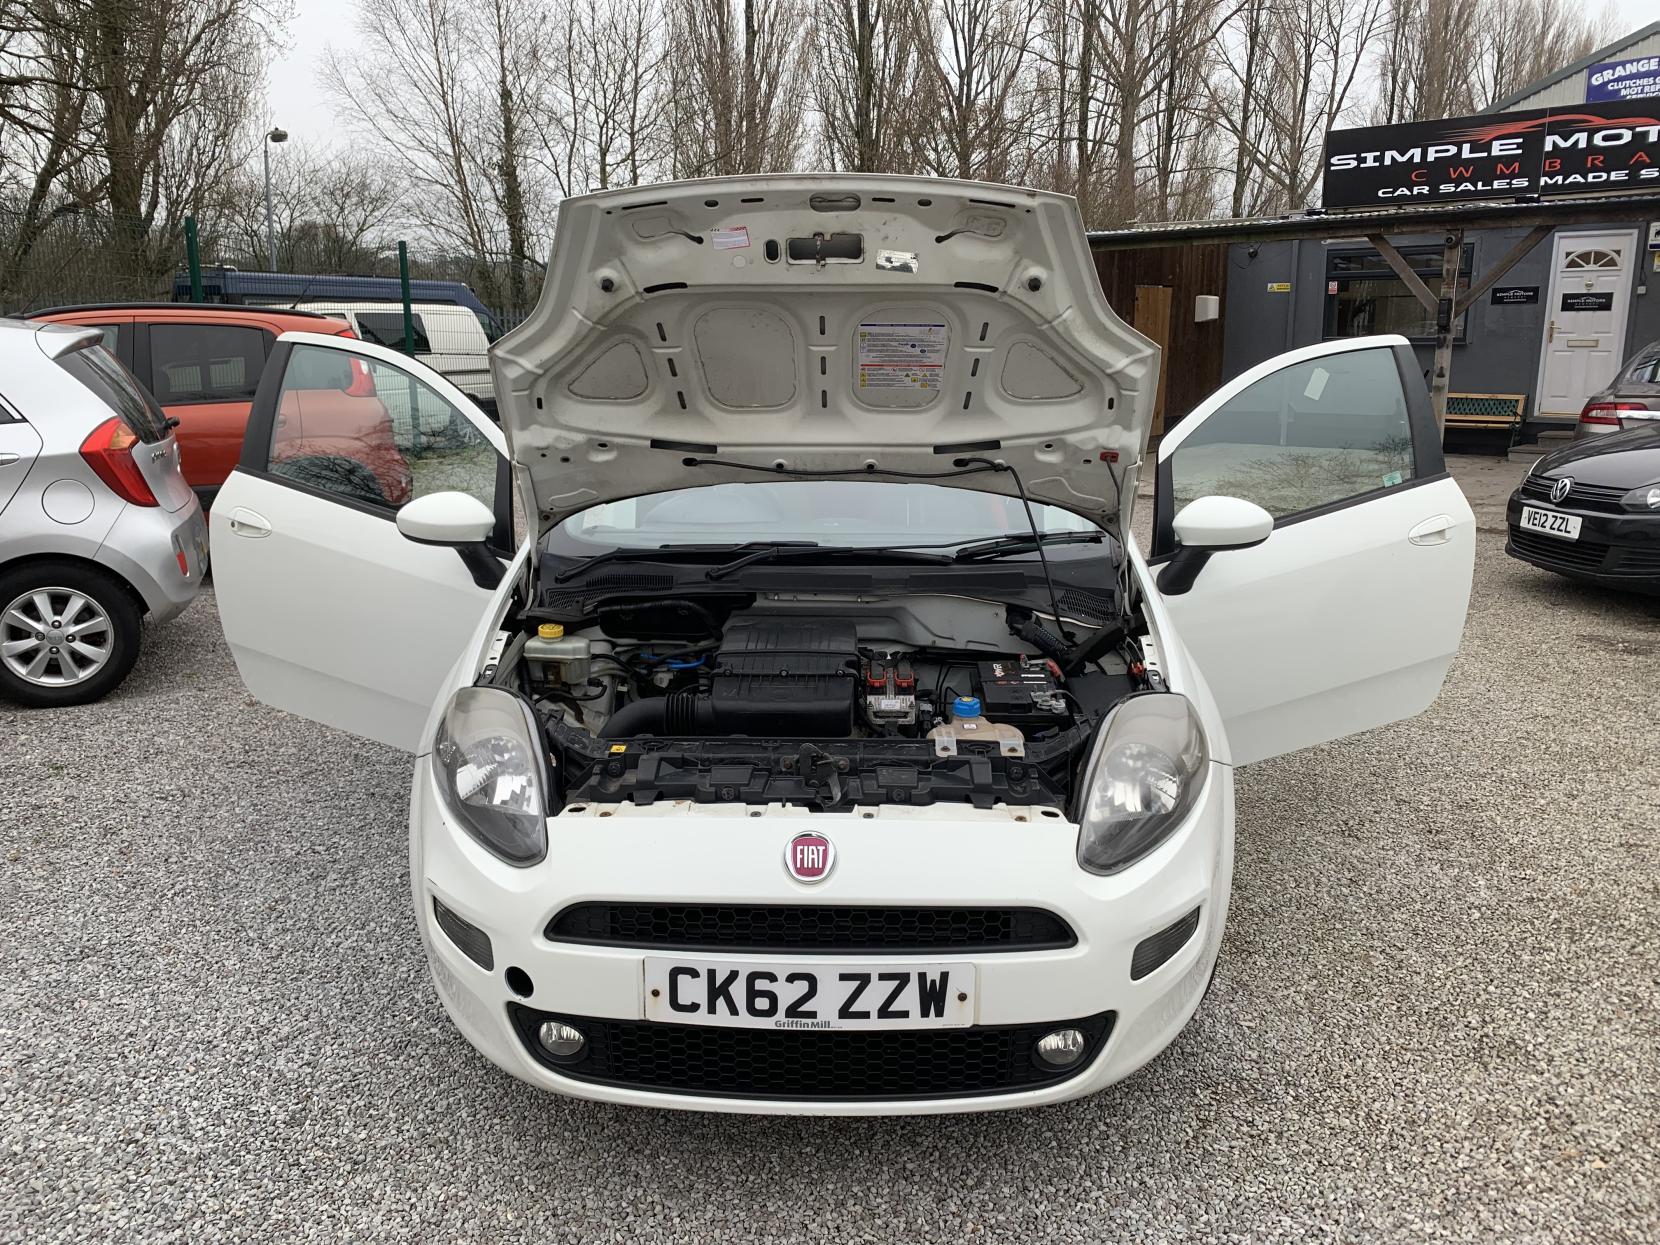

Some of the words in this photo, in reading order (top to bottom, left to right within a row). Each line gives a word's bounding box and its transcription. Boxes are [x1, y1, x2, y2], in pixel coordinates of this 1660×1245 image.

[1591, 58, 1660, 85] GRANGE
[1607, 77, 1654, 90] CLUTCHES
[1620, 86, 1643, 96] MOT
[1330, 138, 1524, 171] SIMPLE
[1544, 125, 1660, 152] MOT
[1377, 186, 1430, 198] CAR
[1439, 178, 1529, 194] SALES
[1540, 170, 1630, 186] MADE
[1527, 509, 1549, 529] VE12
[1549, 515, 1572, 534] ZZL
[796, 845, 826, 869] FIAT
[668, 965, 818, 1019] CK62
[838, 971, 950, 1020] ZZW
